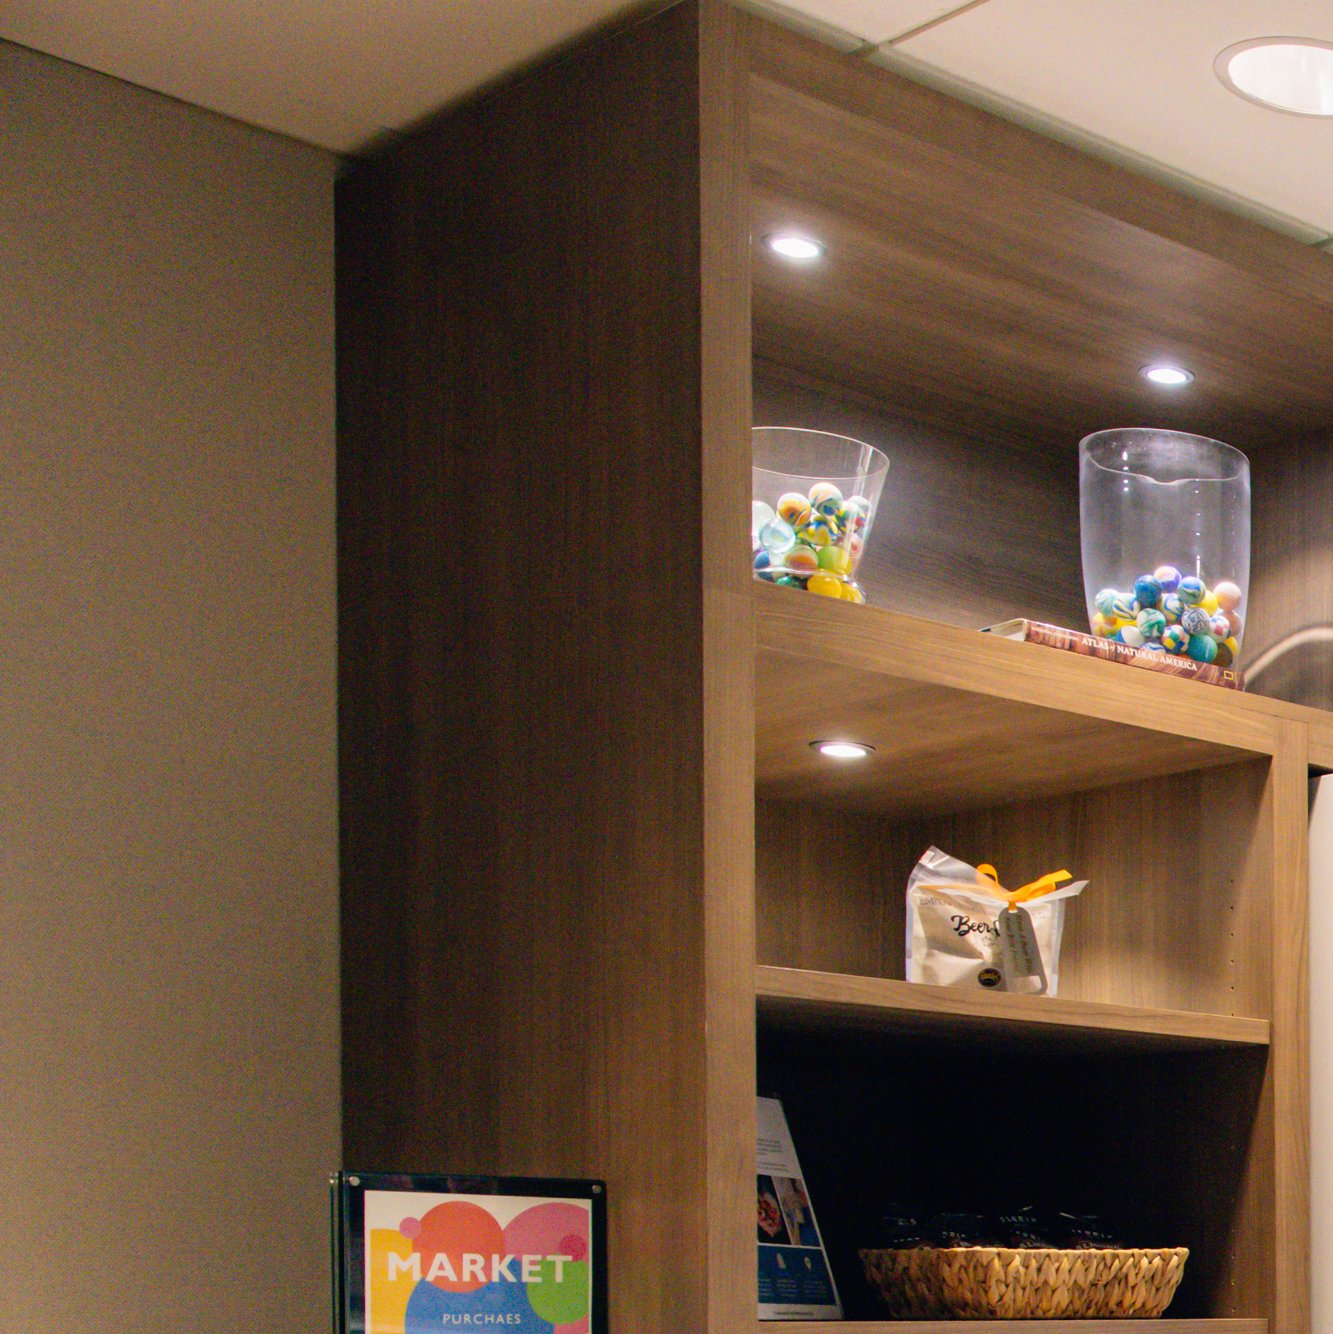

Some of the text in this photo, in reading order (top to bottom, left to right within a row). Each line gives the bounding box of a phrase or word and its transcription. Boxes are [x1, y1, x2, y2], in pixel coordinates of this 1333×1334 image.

[1081, 637, 1198, 672] ATLAS NATURAL AMERICA
[951, 915, 991, 937] Beer
[387, 1251, 573, 1284] MARKET
[442, 1313, 522, 1325] PURCHAES
